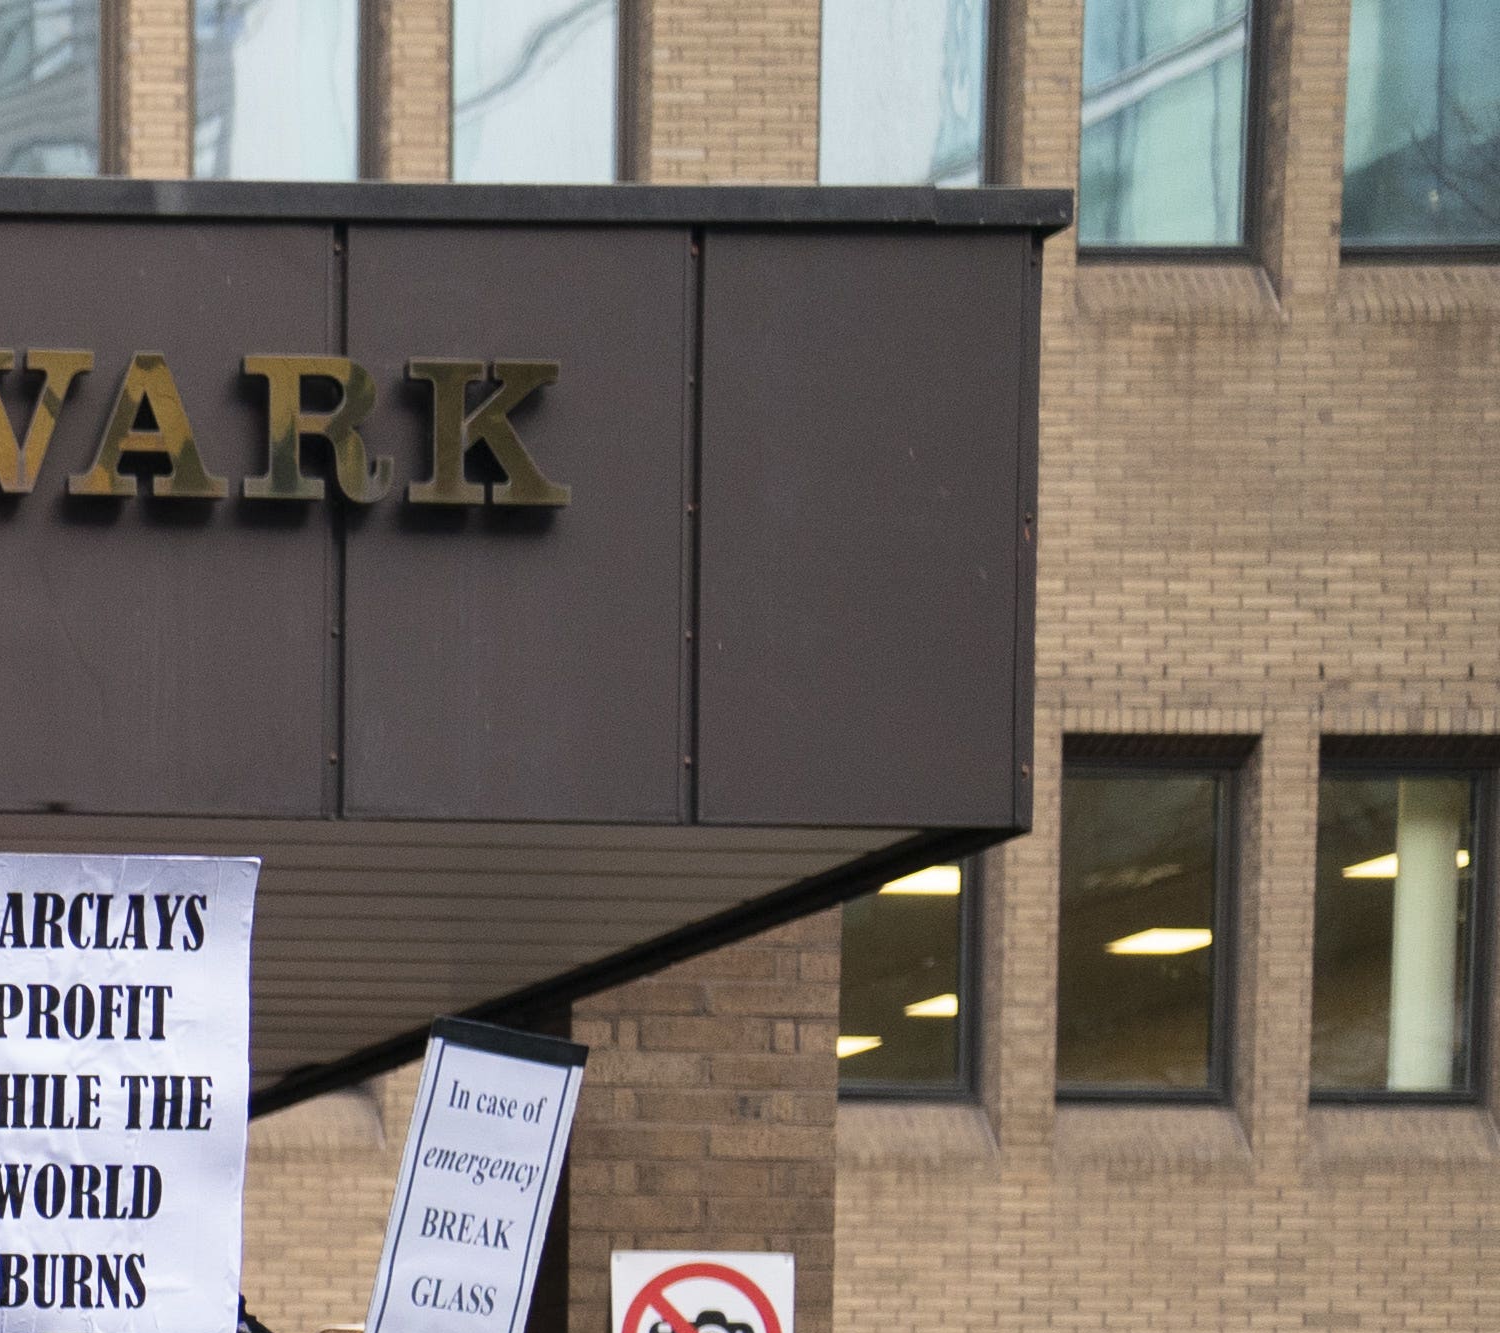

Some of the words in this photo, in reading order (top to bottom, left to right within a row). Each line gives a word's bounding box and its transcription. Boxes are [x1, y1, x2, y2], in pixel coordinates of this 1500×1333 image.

[120, 1075, 214, 1132] THE
[449, 1080, 471, 1110] In
[476, 1091, 518, 1120] case
[523, 1097, 548, 1124] of
[422, 1146, 541, 1193] emergency
[420, 1206, 515, 1251] BREAK
[411, 1275, 498, 1317] GLASS
